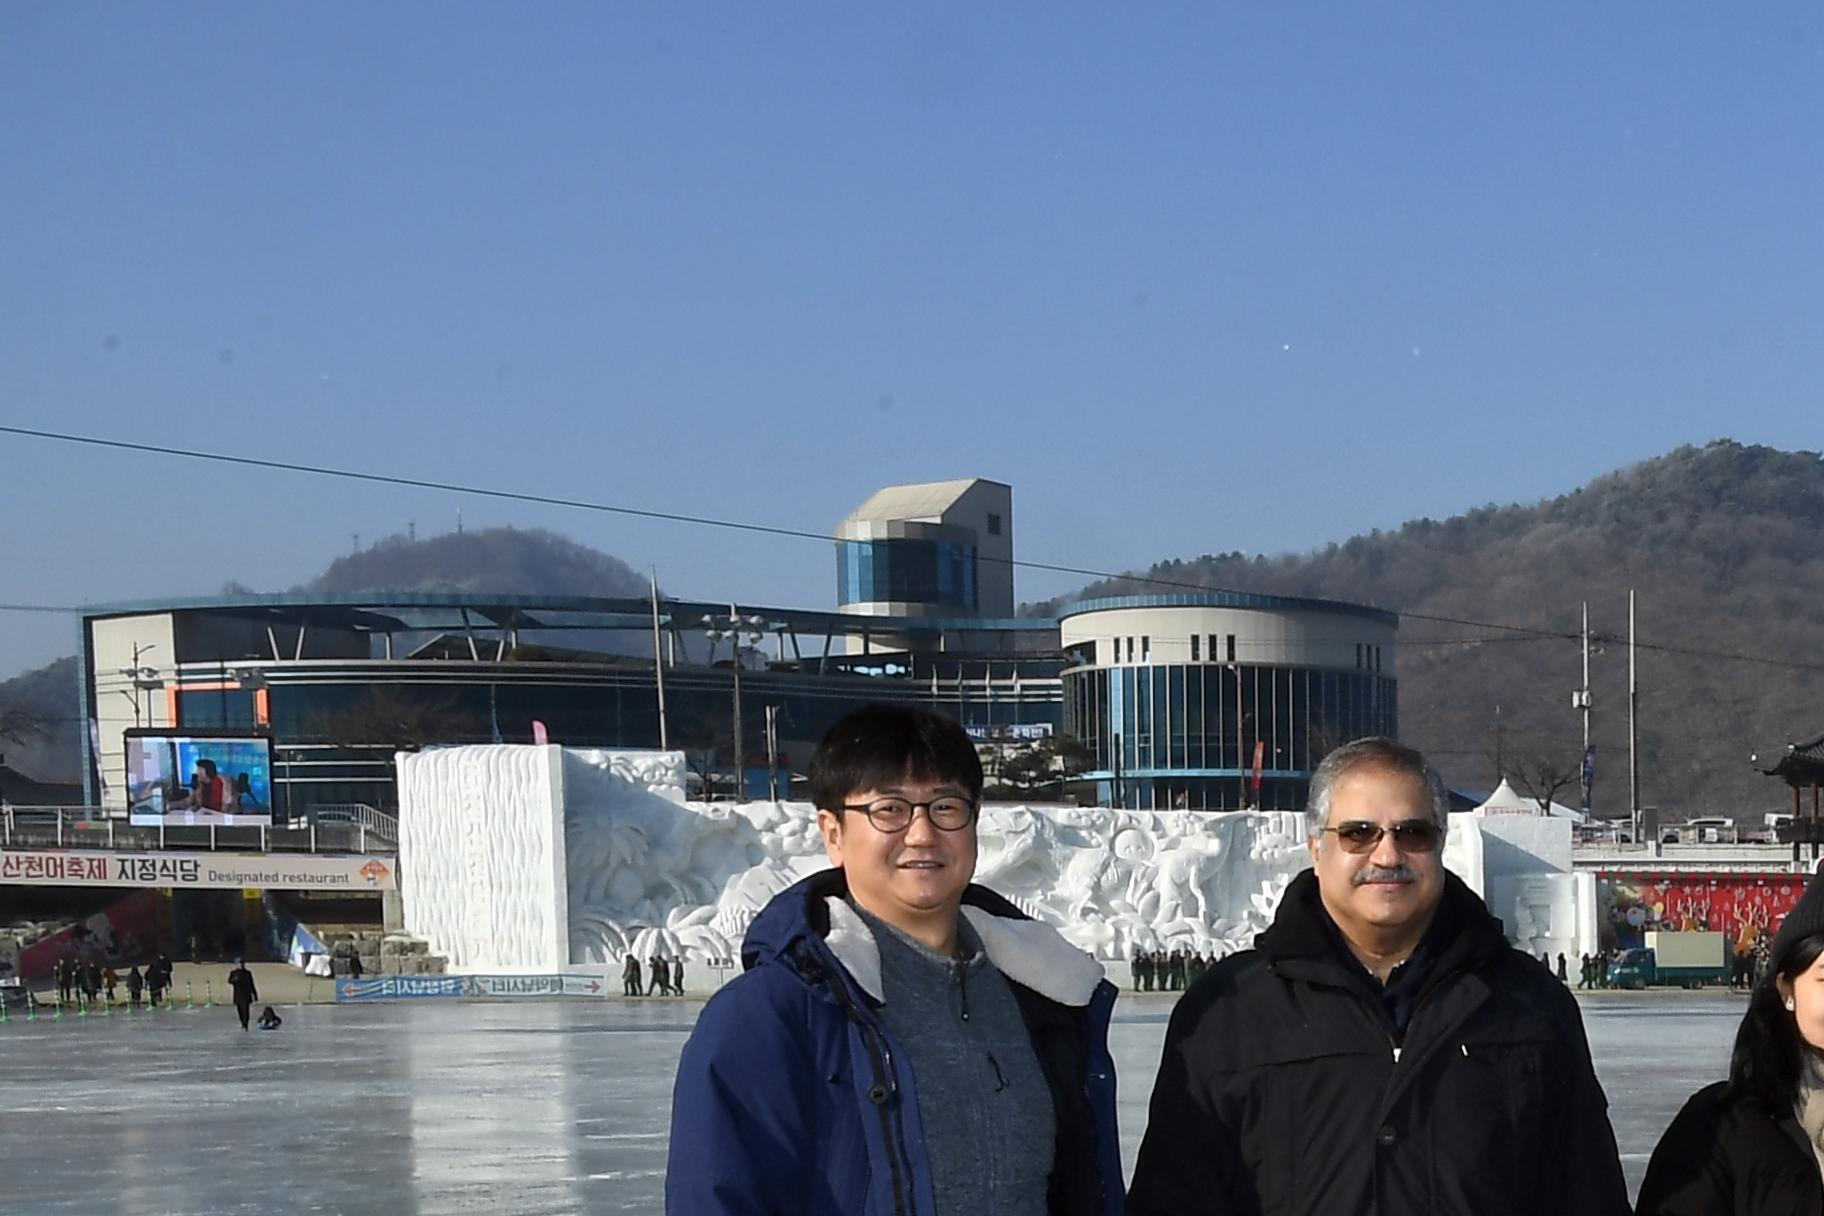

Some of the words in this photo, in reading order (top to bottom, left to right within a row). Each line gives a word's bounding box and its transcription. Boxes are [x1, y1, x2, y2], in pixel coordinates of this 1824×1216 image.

[2, 855, 108, 881] 산천어축제
[117, 857, 201, 882] 지정식당
[208, 870, 279, 884] Designated
[283, 873, 349, 884] restaurant
